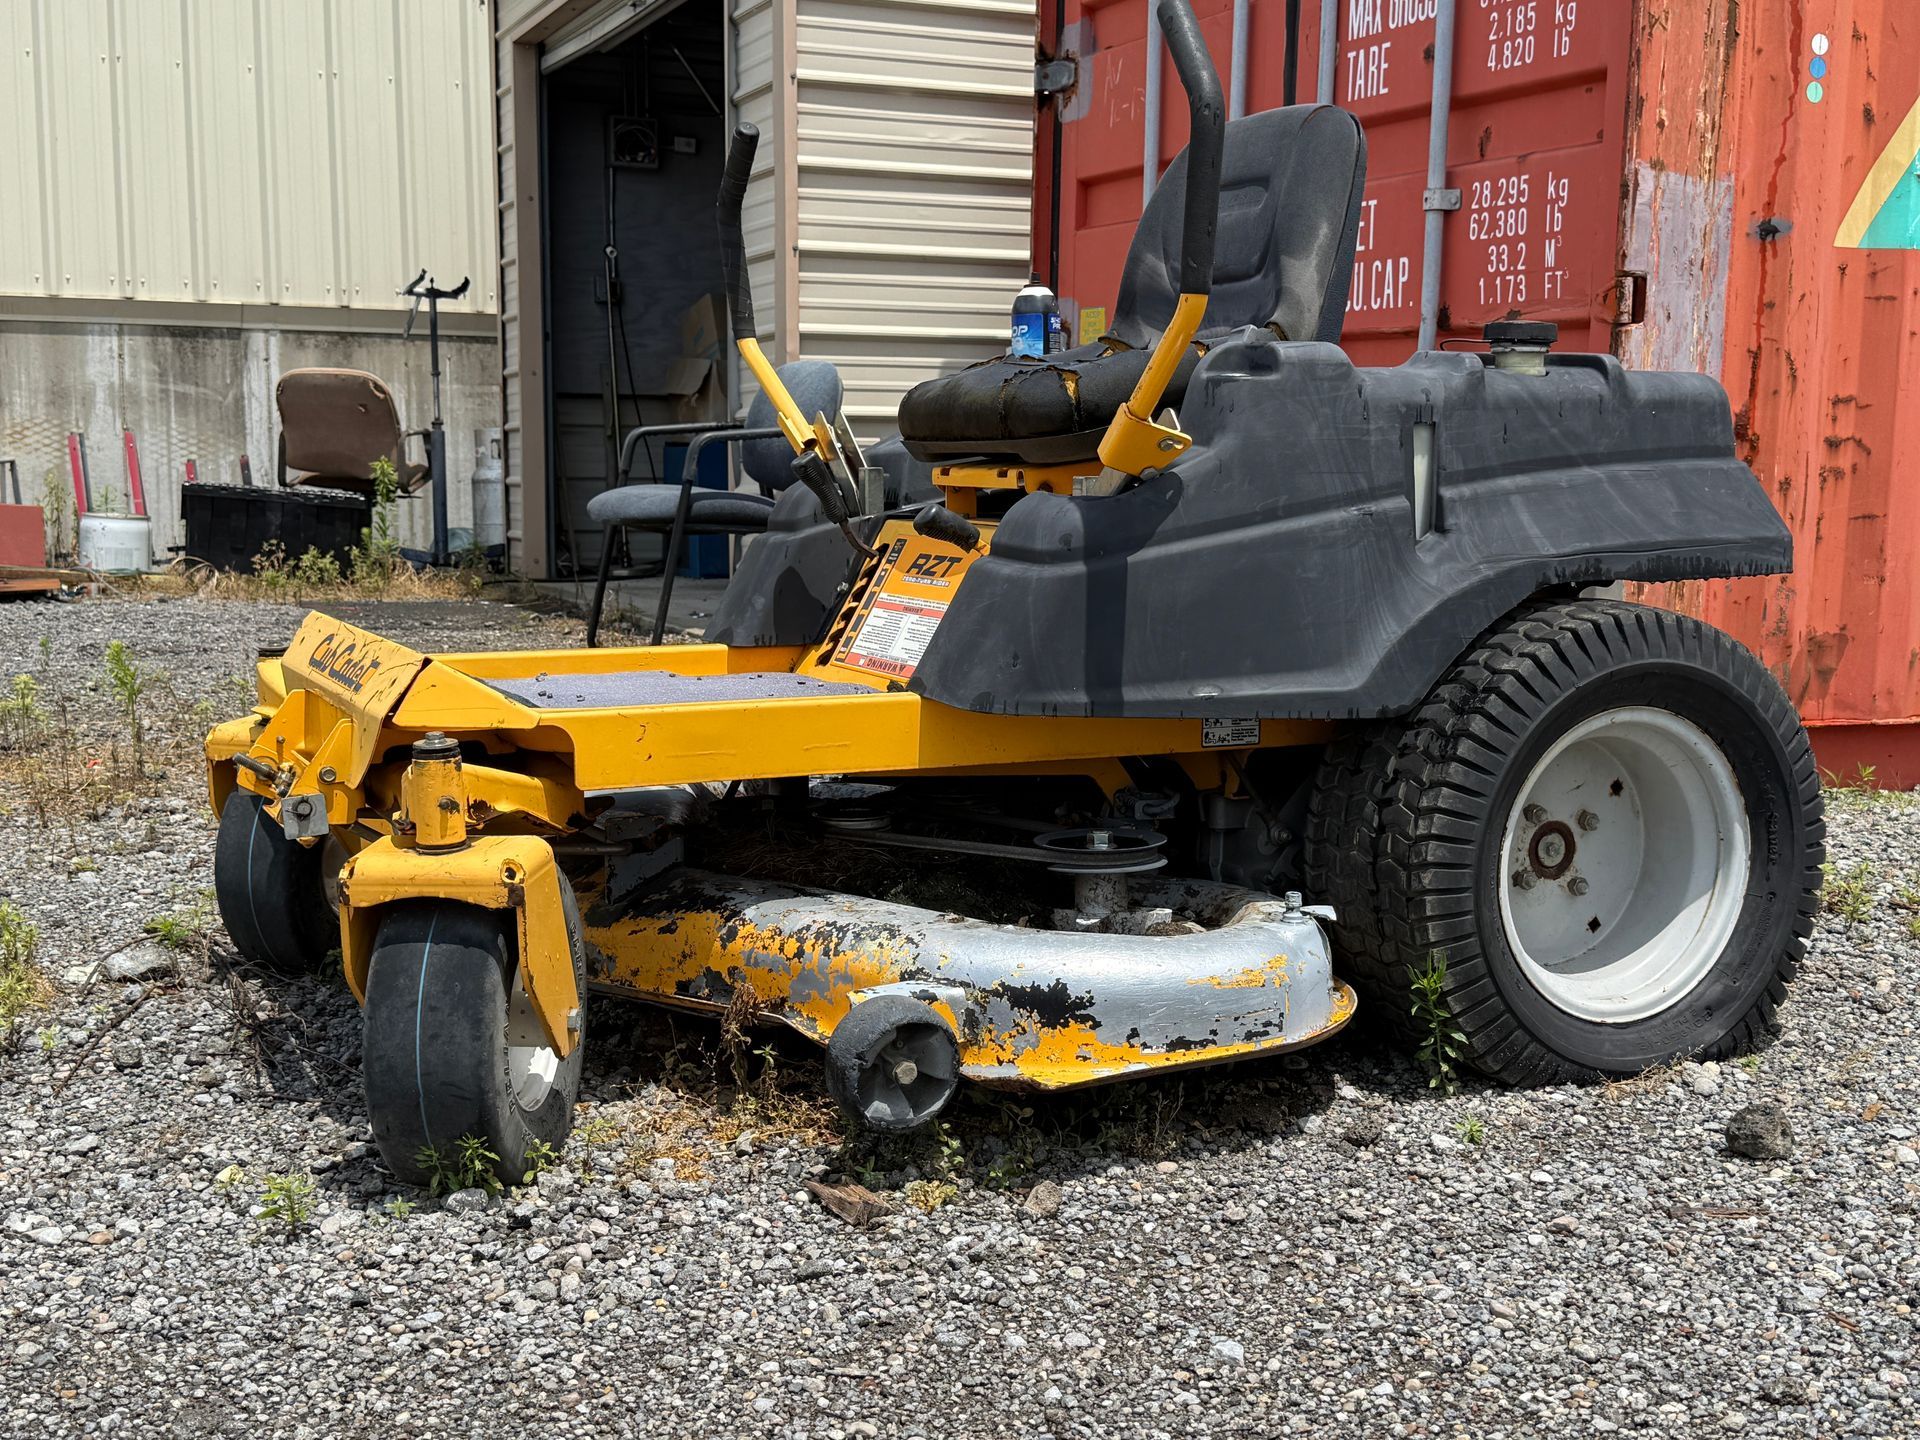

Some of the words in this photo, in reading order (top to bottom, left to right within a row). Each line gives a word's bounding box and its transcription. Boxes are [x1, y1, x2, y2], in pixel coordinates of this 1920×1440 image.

[1348, 0, 1382, 41] MAX
[1489, 2, 1537, 41] 2,185
[1555, 0, 1576, 31] kg
[1487, 35, 1535, 72] 4,820
[1553, 28, 1570, 58] lb
[1347, 42, 1391, 102] TARE
[1471, 174, 1529, 210] 28,295
[1547, 171, 1569, 208] kg
[1355, 199, 1377, 252] ET
[1469, 207, 1528, 241] 62,380
[1546, 203, 1562, 233] lb
[1488, 243, 1526, 273] 33.2
[1479, 275, 1526, 305] 1,173
[906, 553, 963, 578] RZT
[308, 633, 345, 673] Cub
[328, 643, 381, 693] Cadet
[866, 657, 899, 670] WARNING
